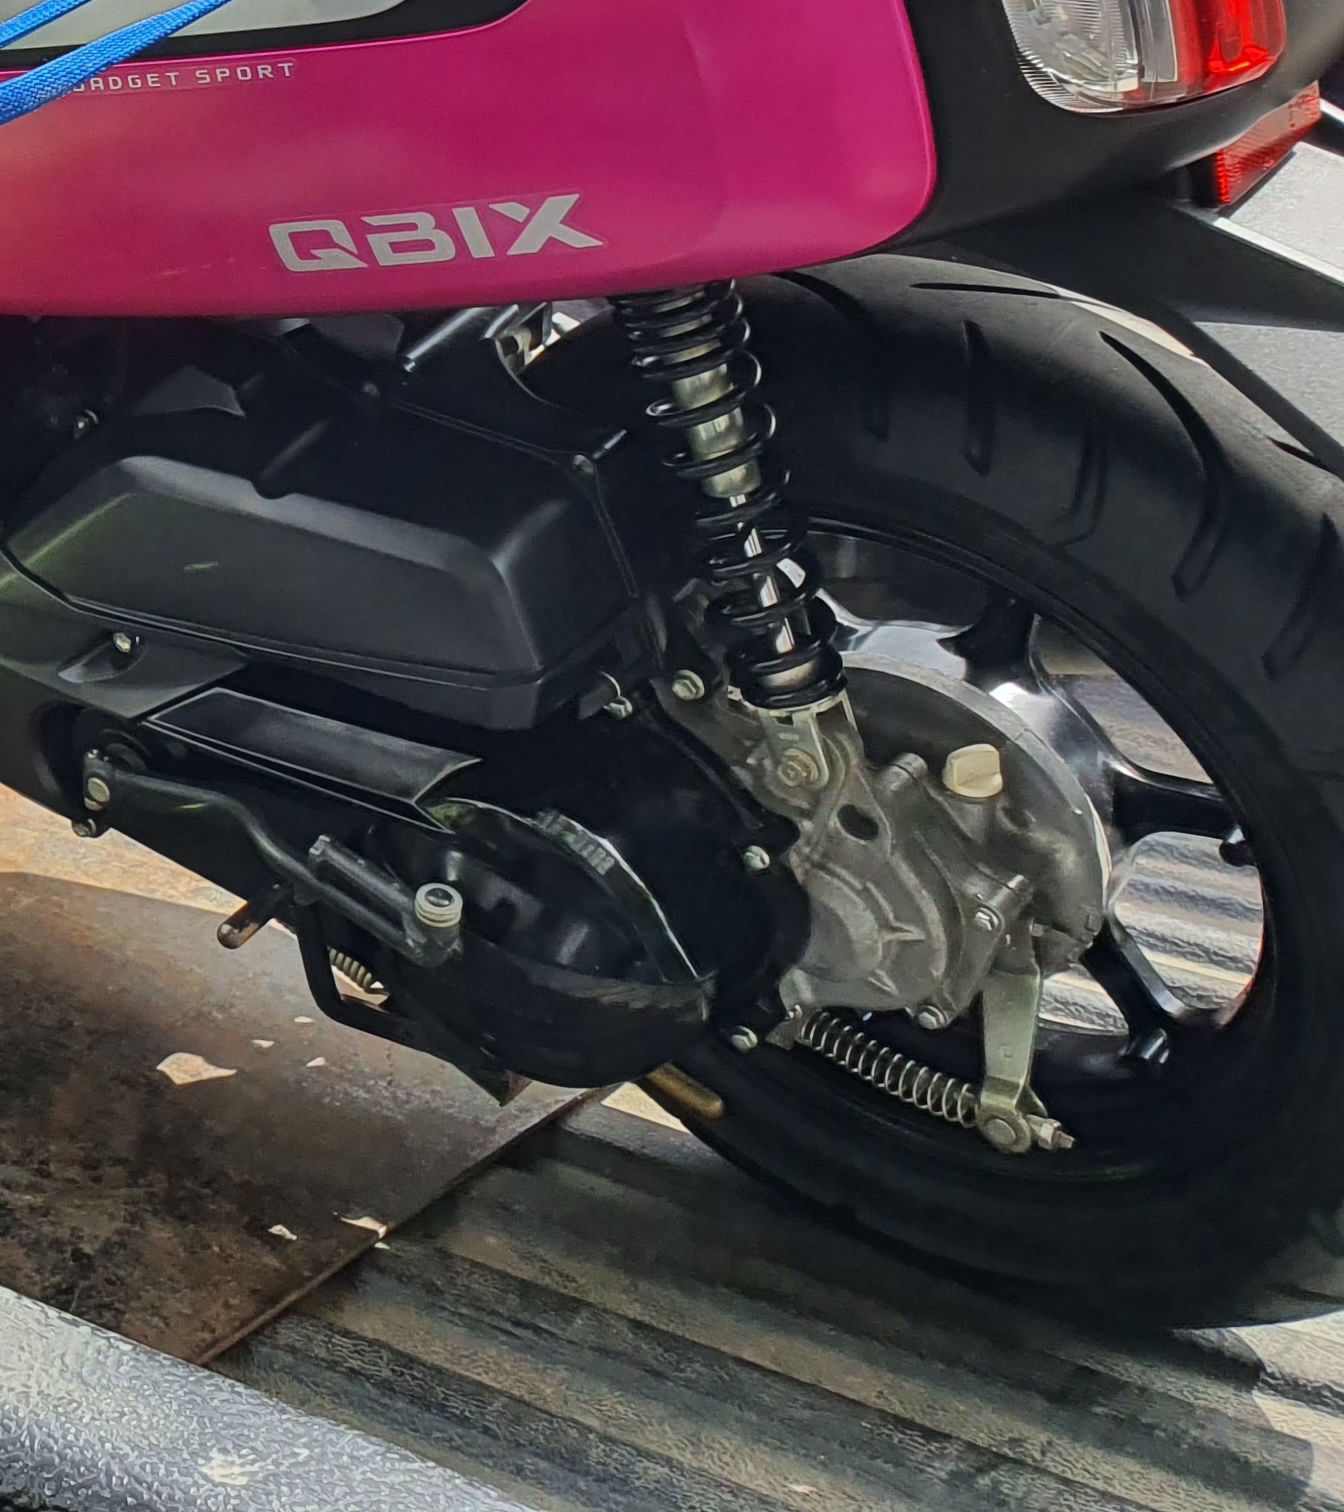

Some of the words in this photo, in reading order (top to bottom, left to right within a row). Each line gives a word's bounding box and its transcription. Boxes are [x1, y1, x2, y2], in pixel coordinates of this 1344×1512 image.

[74, 71, 179, 92] ADGET
[195, 62, 294, 85] SPORT
[268, 191, 604, 273] QBIX
